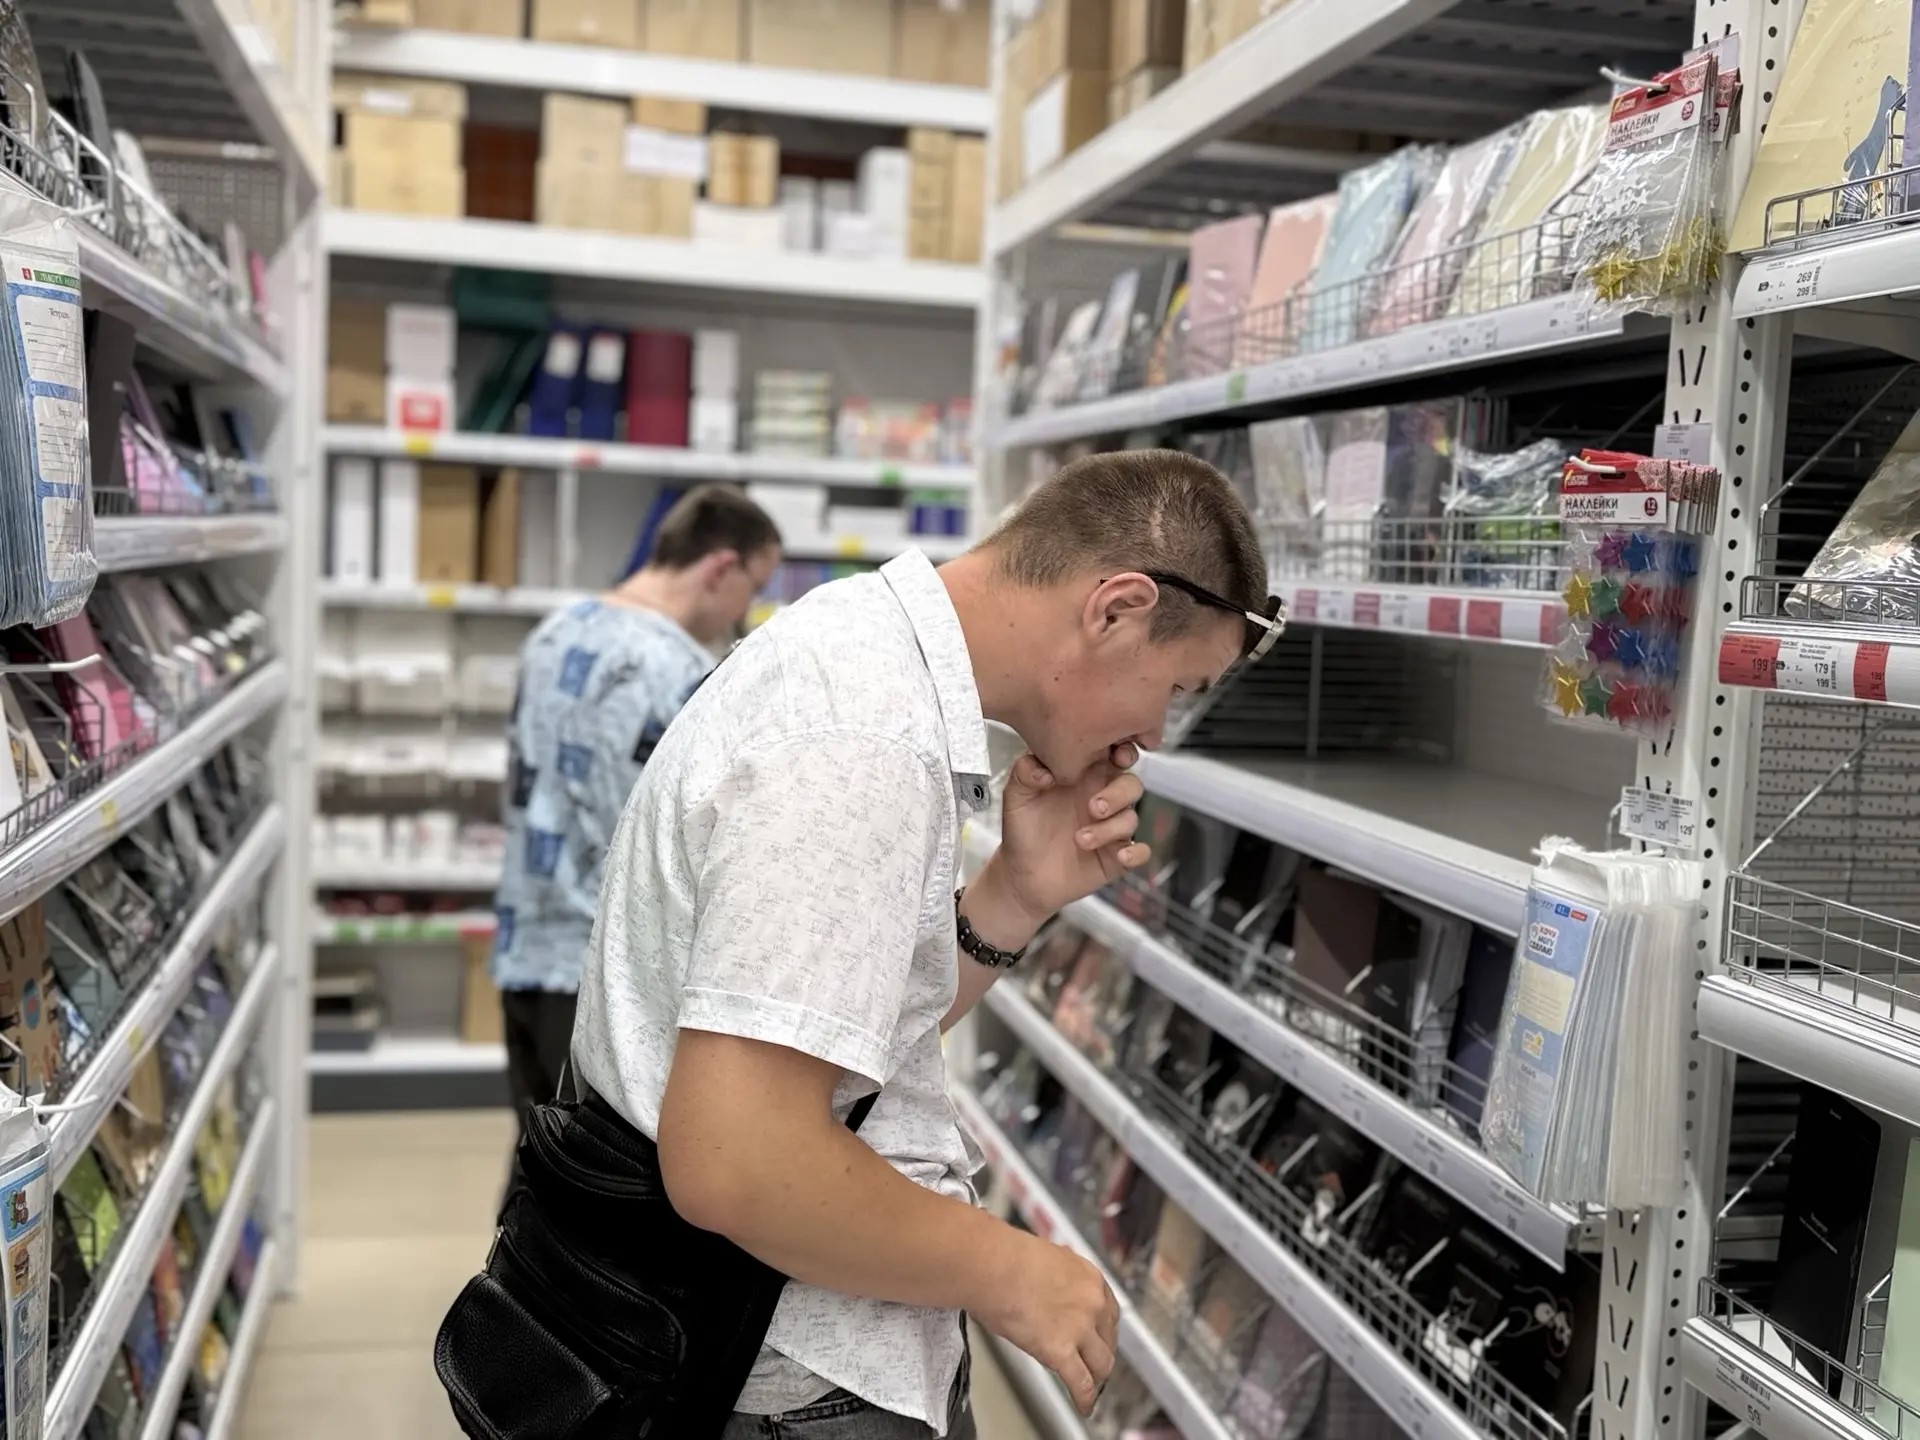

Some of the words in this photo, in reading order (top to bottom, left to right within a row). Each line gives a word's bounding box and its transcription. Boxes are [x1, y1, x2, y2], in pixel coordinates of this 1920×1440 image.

[1611, 112, 1660, 135] НАКЛЕЙКИ
[1796, 271, 1812, 283] 269
[1564, 496, 1618, 510] НАКЛЕЙКИ
[1647, 500, 1657, 509] 12
[1752, 658, 1769, 671] 199
[1814, 662, 1829, 674] 179
[1815, 678, 1830, 688] 199
